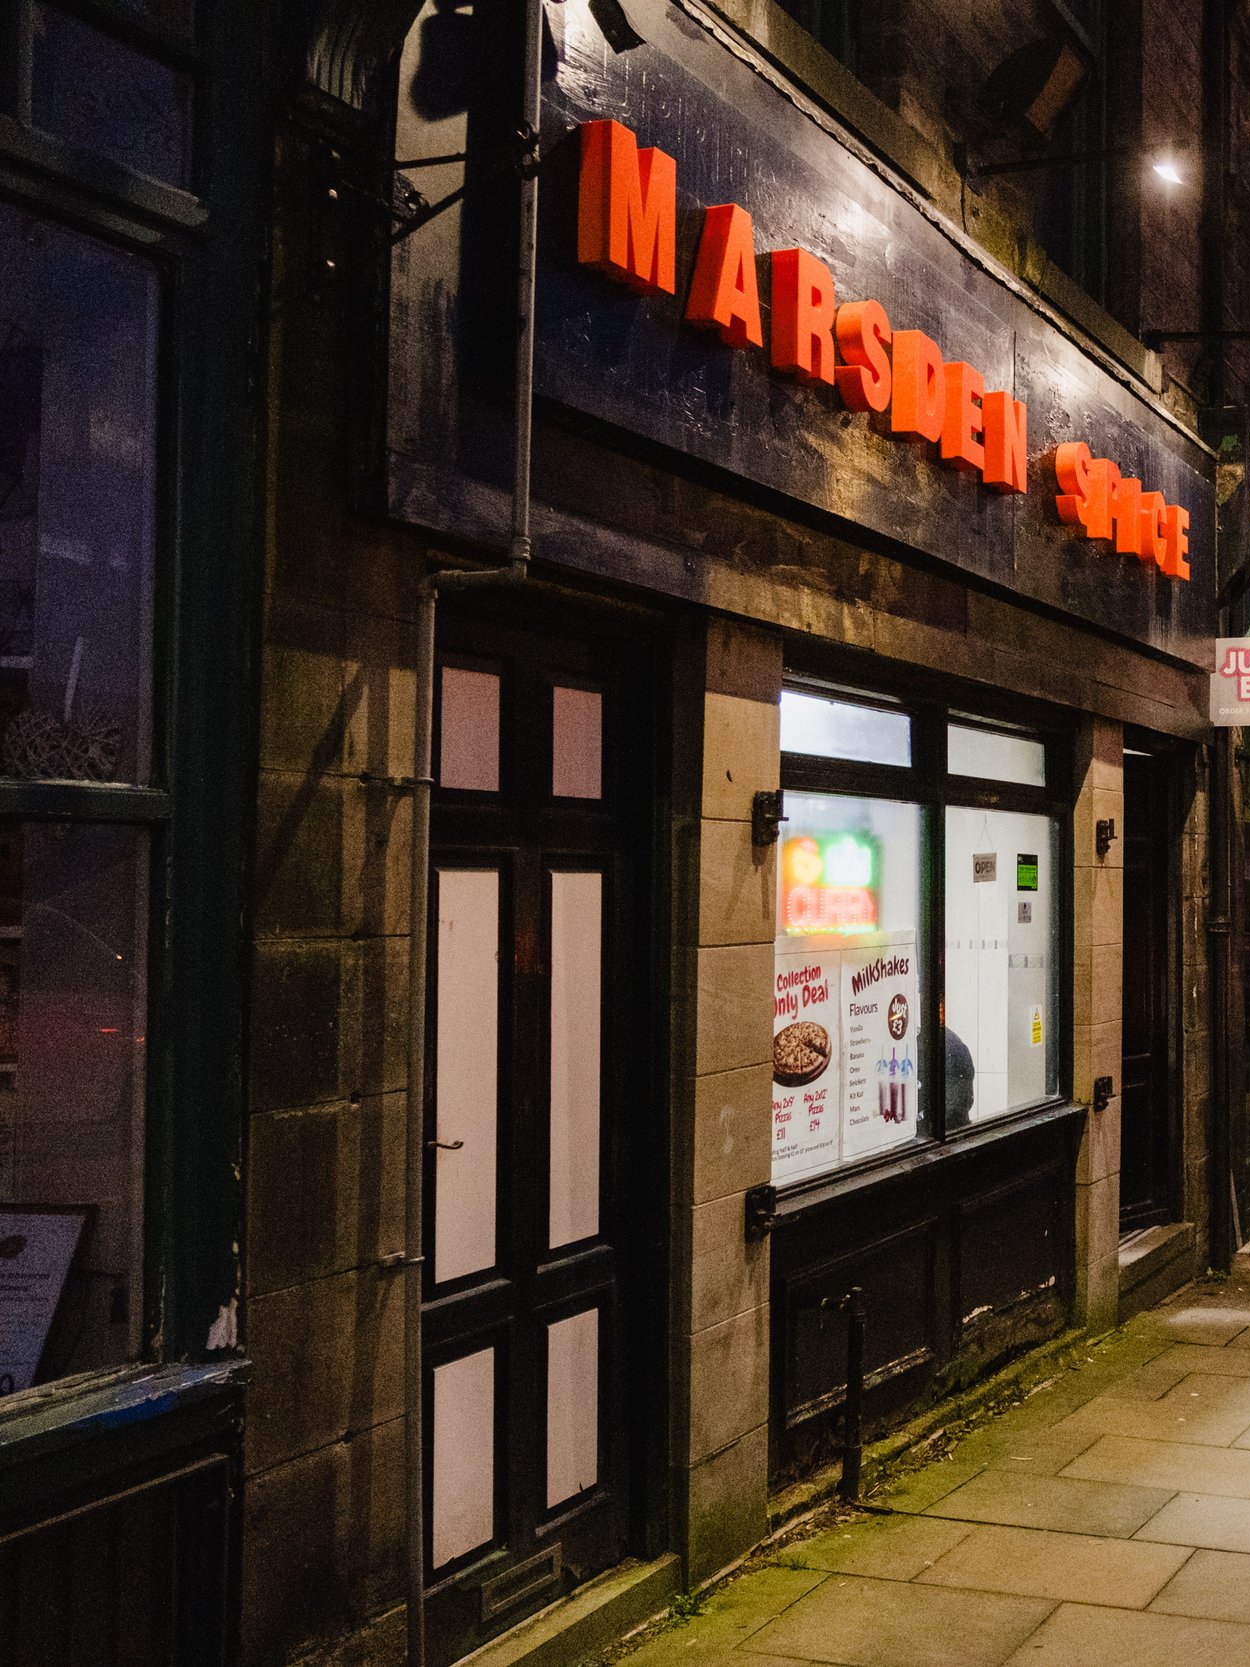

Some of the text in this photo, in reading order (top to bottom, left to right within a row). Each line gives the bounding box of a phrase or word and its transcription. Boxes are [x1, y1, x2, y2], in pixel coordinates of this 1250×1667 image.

[577, 118, 1190, 581] MARSDEN SPICE
[974, 861, 996, 873] OPEN
[776, 966, 821, 992] Collection
[802, 979, 829, 1008] Deal
[849, 1003, 878, 1017] Flavours
[892, 1019, 903, 1035] £3
[809, 1118, 821, 1132] £14
